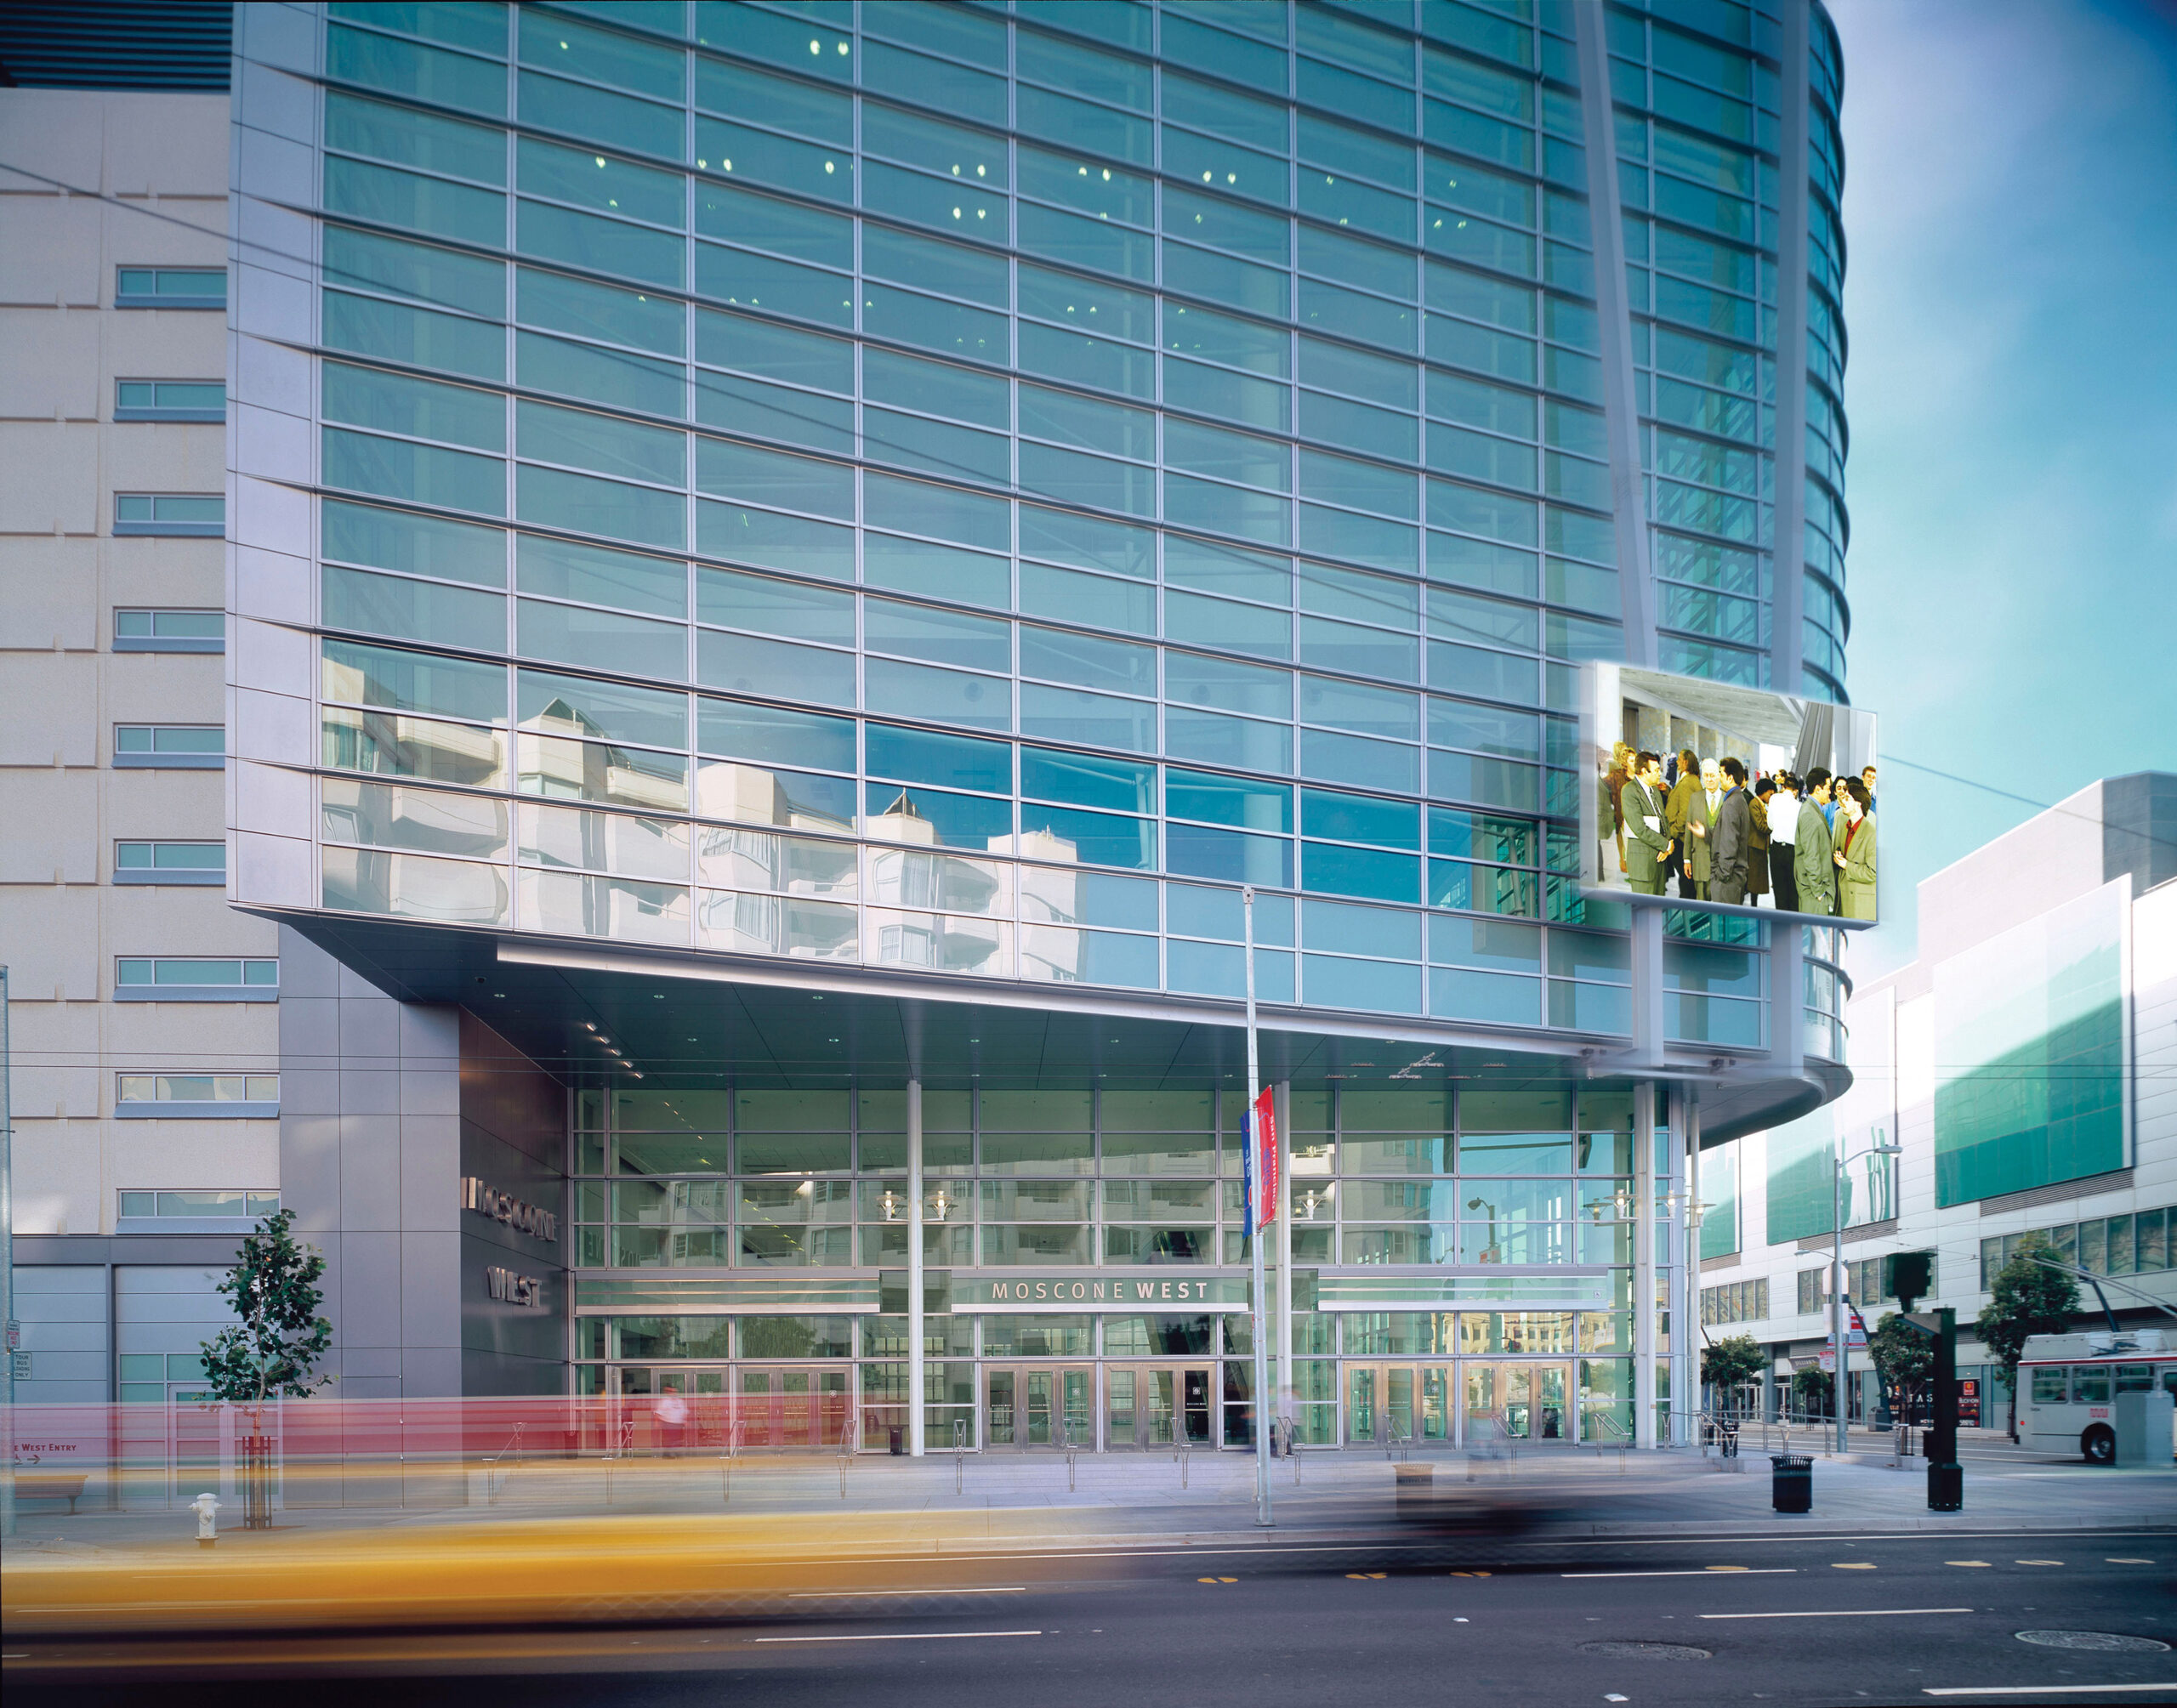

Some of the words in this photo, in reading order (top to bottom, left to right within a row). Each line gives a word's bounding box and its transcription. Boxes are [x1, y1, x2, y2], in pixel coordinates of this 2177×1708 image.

[460, 1177, 557, 1242] MOSCONE
[487, 1265, 543, 1308] WEST
[992, 1282, 1123, 1299] MOSCONE
[1136, 1281, 1208, 1299] WEST
